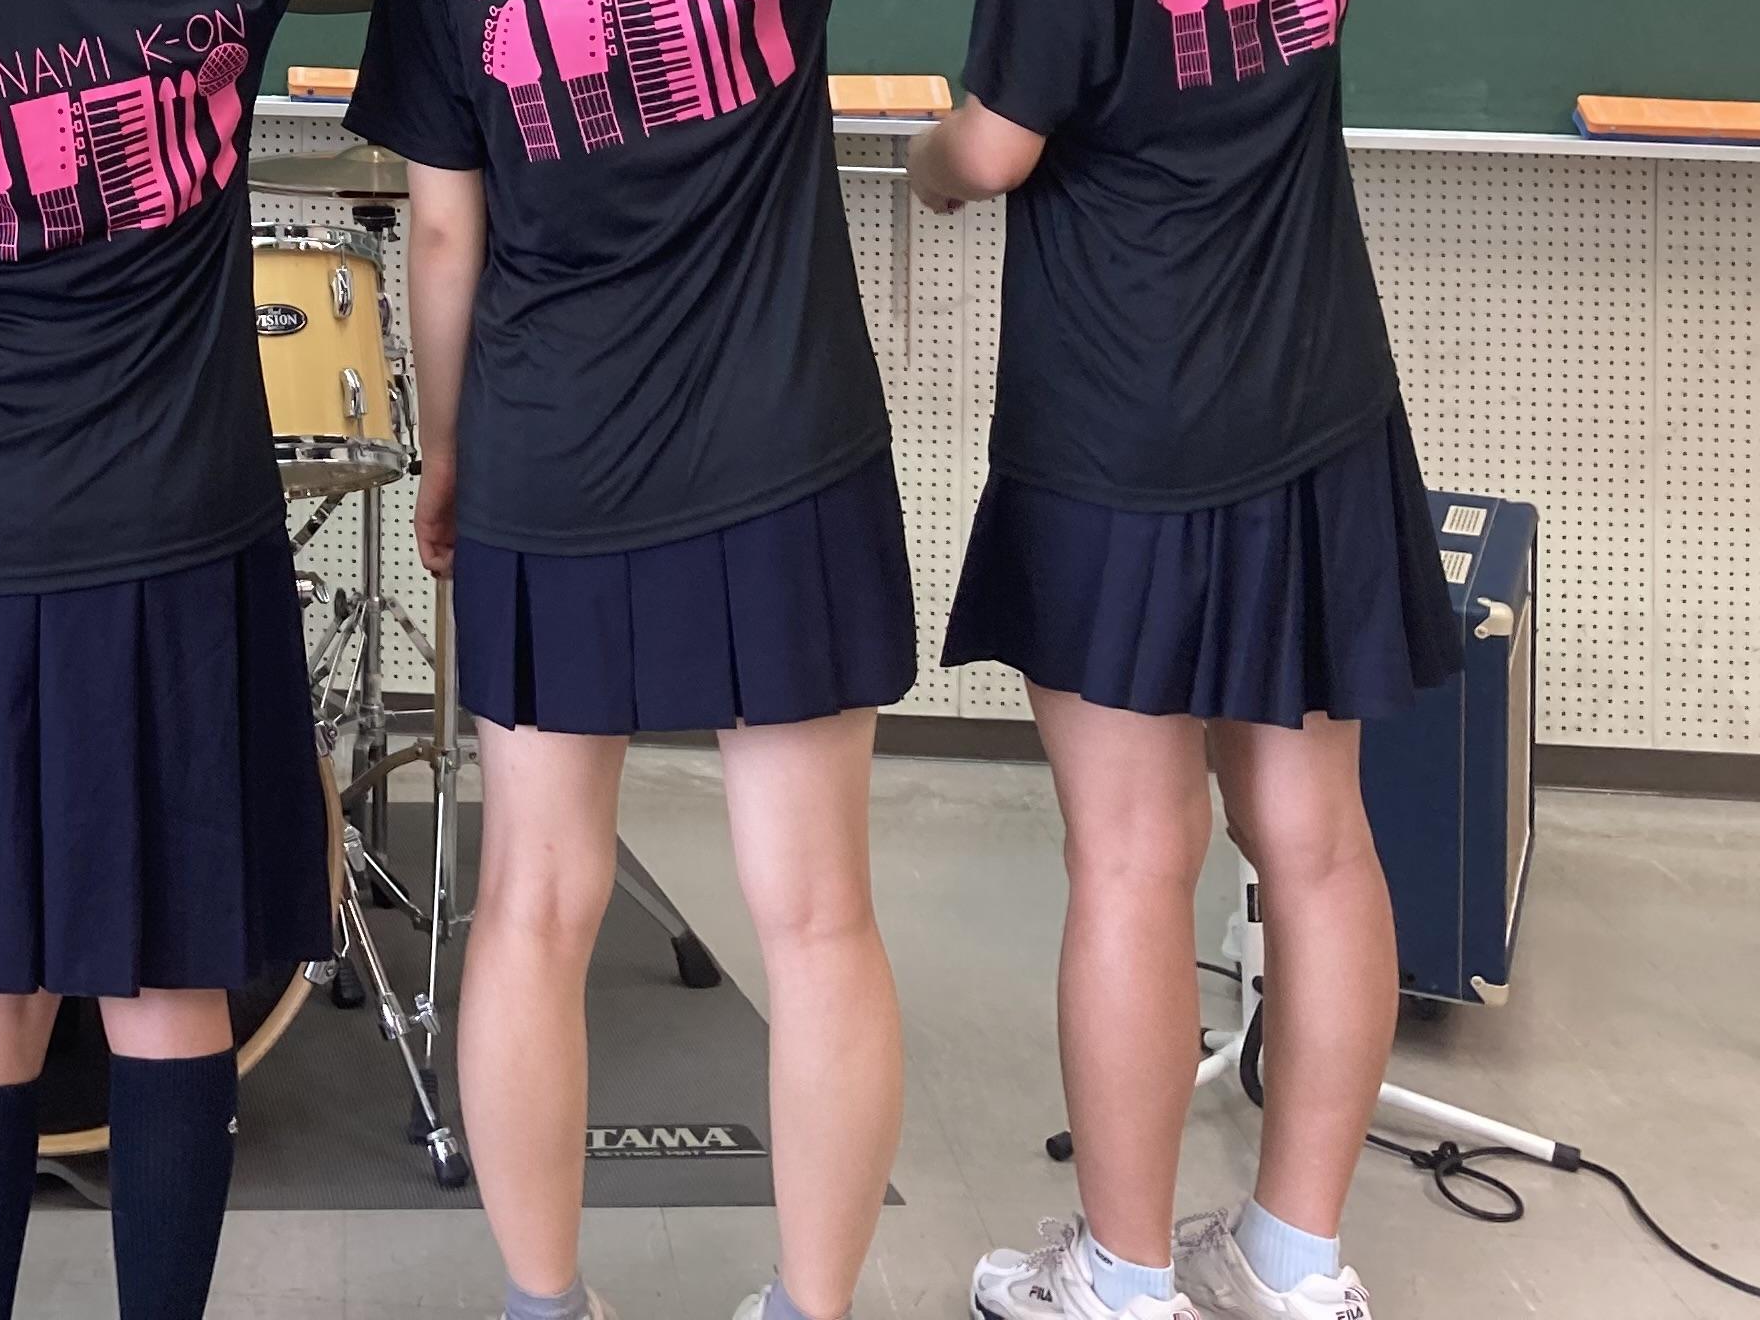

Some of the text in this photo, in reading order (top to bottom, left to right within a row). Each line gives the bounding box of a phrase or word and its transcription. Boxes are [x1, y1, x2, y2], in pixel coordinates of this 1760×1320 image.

[136, 3, 245, 71] K-ON
[587, 1127, 739, 1149] TAMA
[1029, 1285, 1052, 1303] FILA
